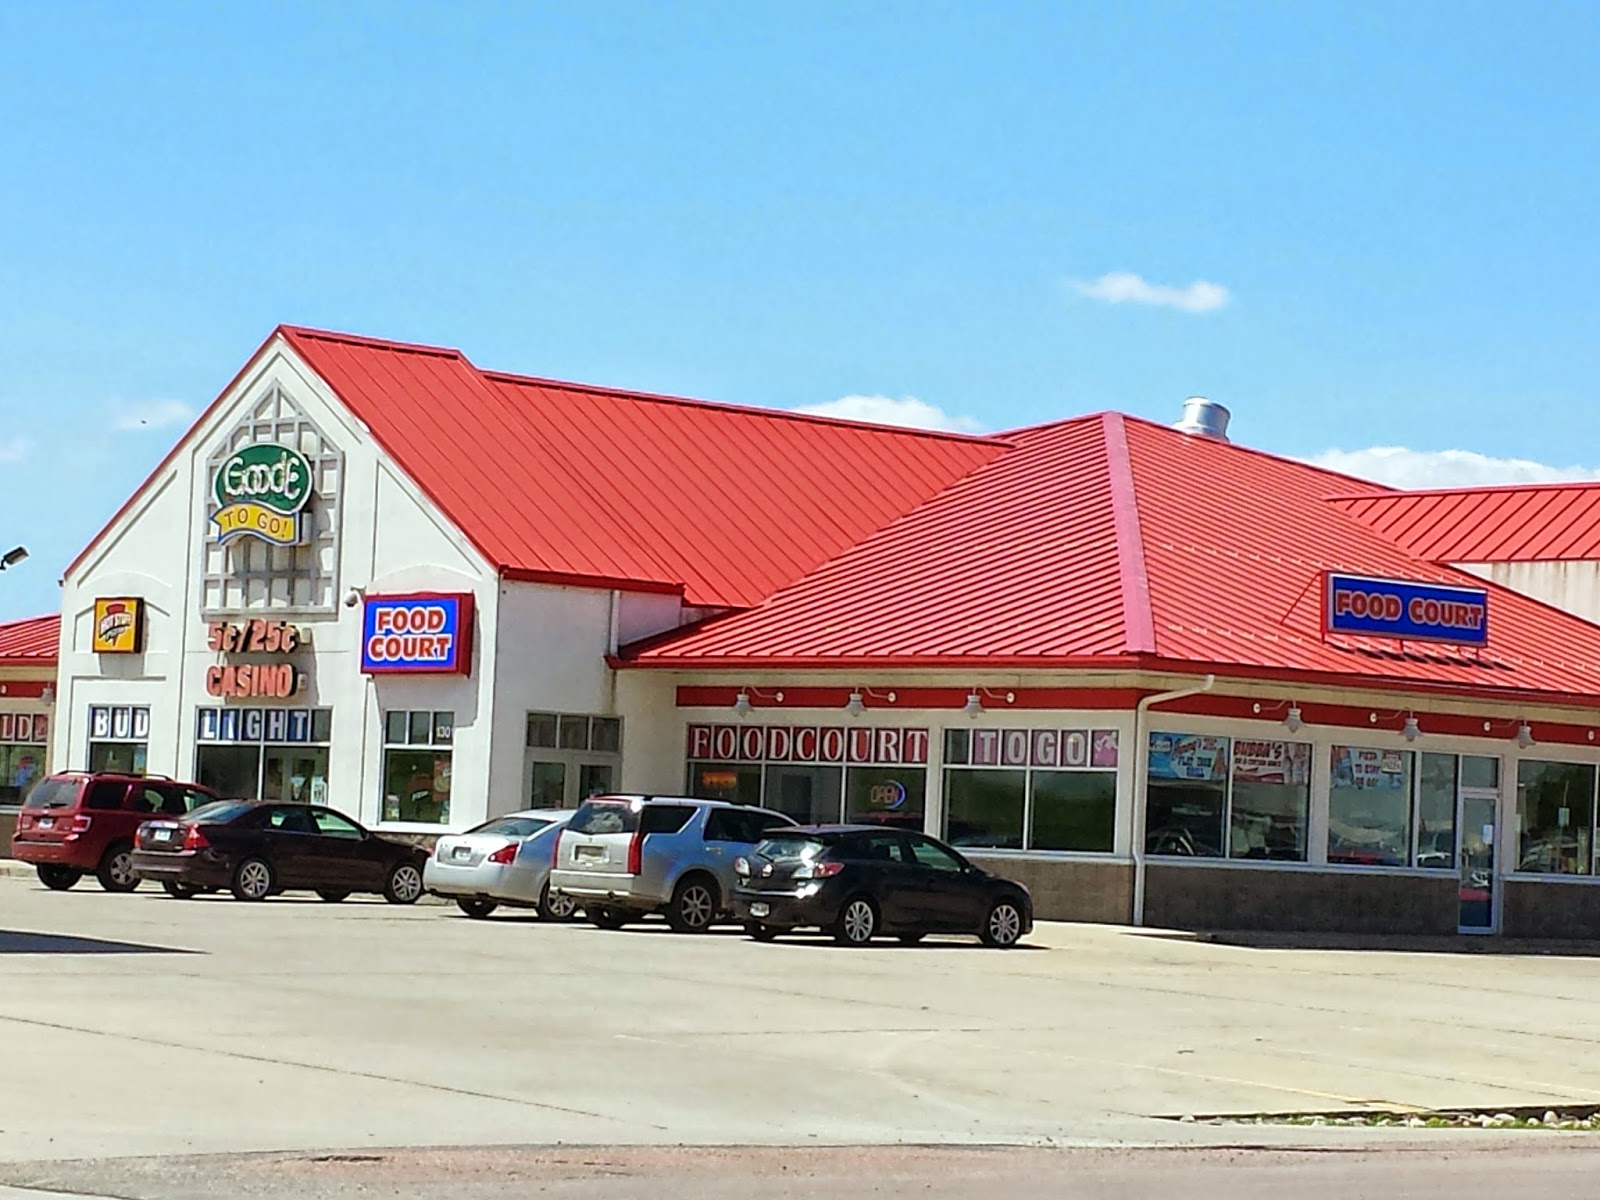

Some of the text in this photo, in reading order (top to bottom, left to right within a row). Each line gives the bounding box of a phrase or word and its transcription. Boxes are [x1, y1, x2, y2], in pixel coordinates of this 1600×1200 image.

[223, 507, 290, 539] TO GO!
[375, 606, 447, 634] FOOD
[1335, 589, 1485, 631] FOOD COURT
[367, 633, 453, 662] COURT
[206, 663, 293, 698] CASINO
[94, 708, 149, 738] BUD
[201, 709, 308, 740] LIGHT
[870, 785, 898, 804] OPEN
